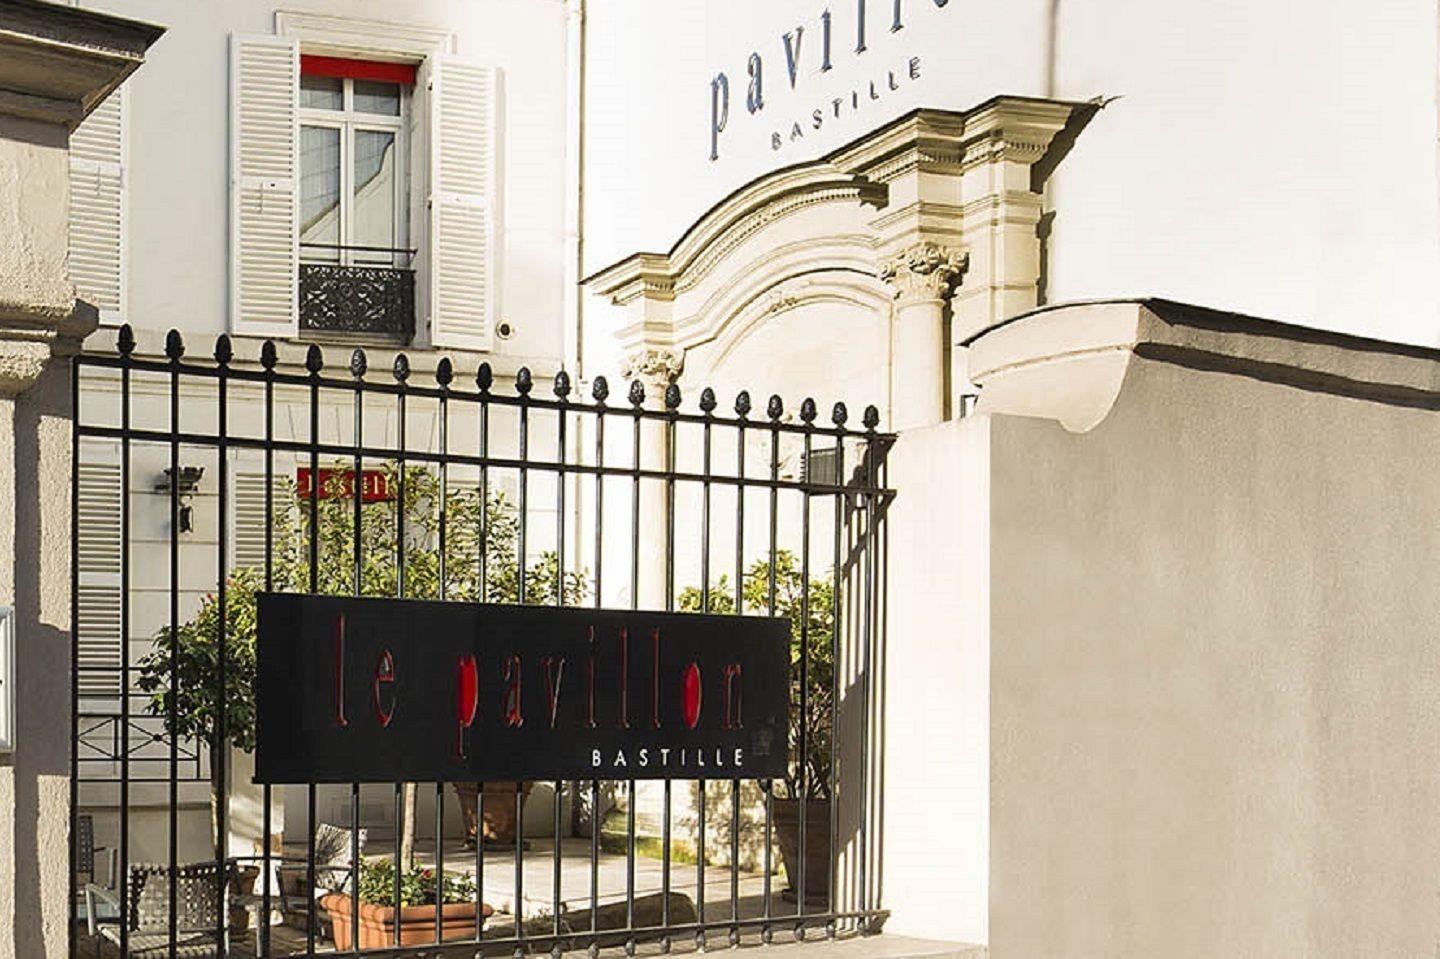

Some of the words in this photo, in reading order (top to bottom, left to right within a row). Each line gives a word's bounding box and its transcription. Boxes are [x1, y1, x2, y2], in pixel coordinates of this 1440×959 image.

[771, 56, 922, 152] BASTILLE
[334, 612, 397, 729] le
[456, 624, 745, 760] pavillon
[592, 748, 744, 768] BASTILLE
